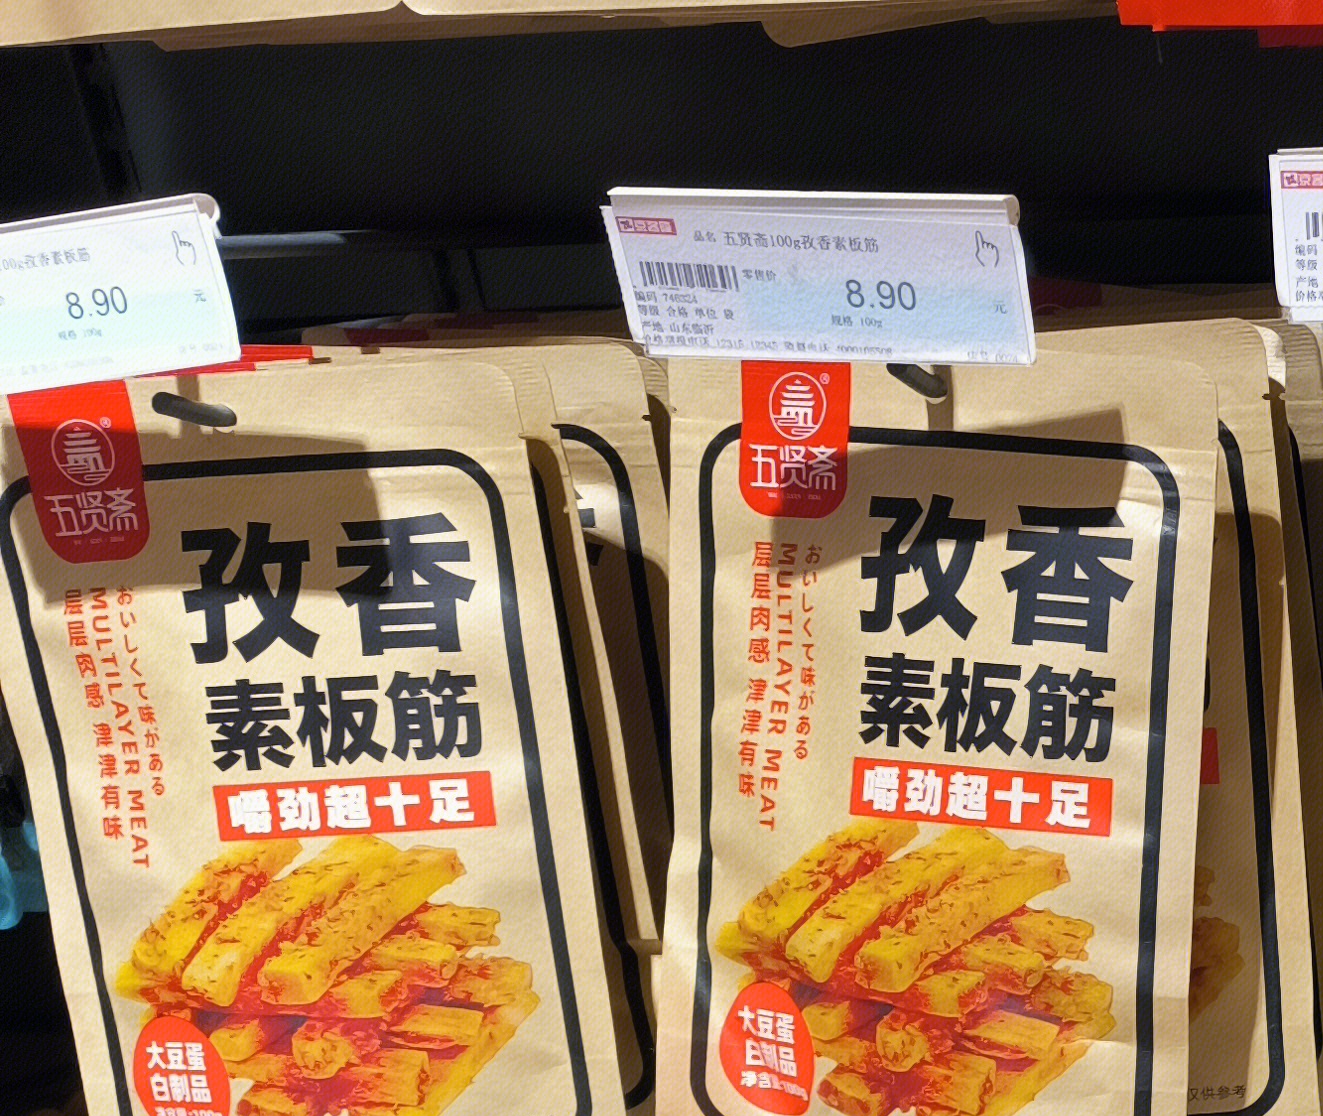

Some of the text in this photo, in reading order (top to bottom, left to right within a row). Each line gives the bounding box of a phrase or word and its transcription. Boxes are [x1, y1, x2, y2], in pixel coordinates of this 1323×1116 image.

[723, 230, 879, 254] 五贤斋100g孜香素板筋
[65, 285, 128, 320] 8.90
[845, 278, 917, 312] 8.90
[993, 301, 1008, 315] 元
[748, 442, 838, 492] 五贤斋
[43, 487, 139, 537] 五贤斋
[181, 512, 476, 664] 孜香
[860, 493, 1134, 654] 孜香
[758, 542, 798, 832] MULTILAYER MEAT
[858, 652, 1115, 763] 素板筋
[90, 587, 151, 868] MULTILAYER MEAT
[206, 670, 484, 772] 素板筋
[227, 778, 475, 837] 嚼劲超十足
[861, 764, 1093, 830] 嚼劲超十足
[737, 1005, 796, 1045] 大豆蛋
[146, 1040, 206, 1072] 大豆蛋
[149, 1074, 213, 1105] 白制品
